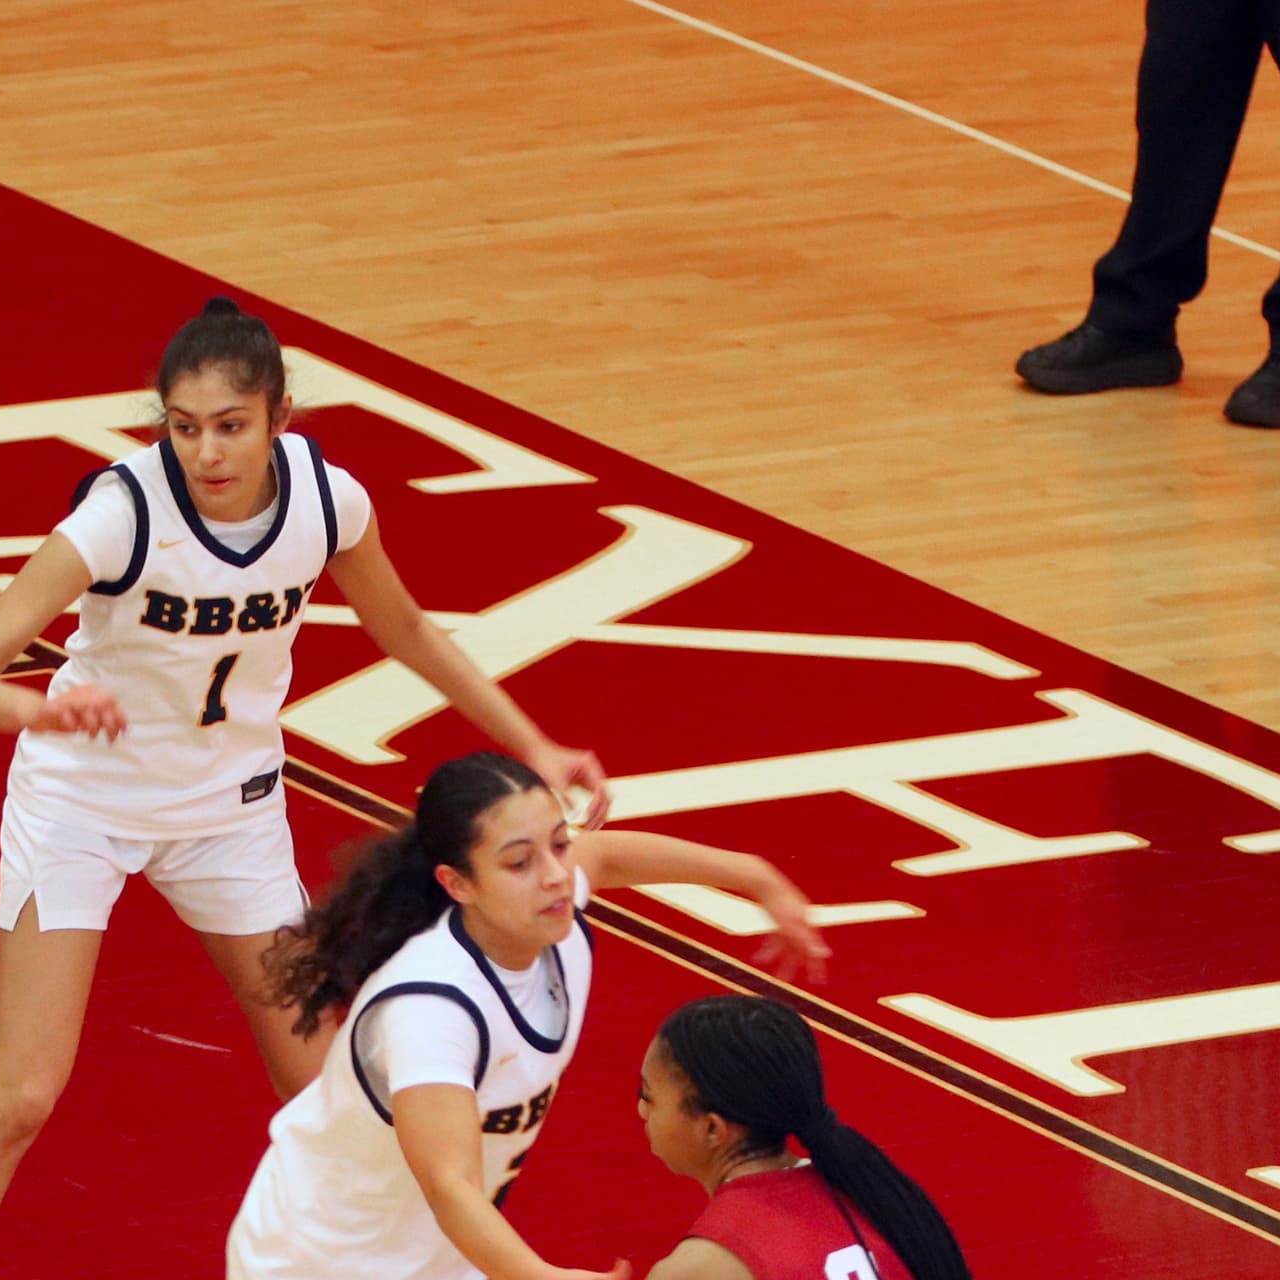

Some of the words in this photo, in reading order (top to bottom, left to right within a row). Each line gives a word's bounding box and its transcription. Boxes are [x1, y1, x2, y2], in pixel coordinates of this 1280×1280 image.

[139, 576, 318, 637] BB&N
[198, 651, 242, 728] 1
[481, 1084, 556, 1135] BB
